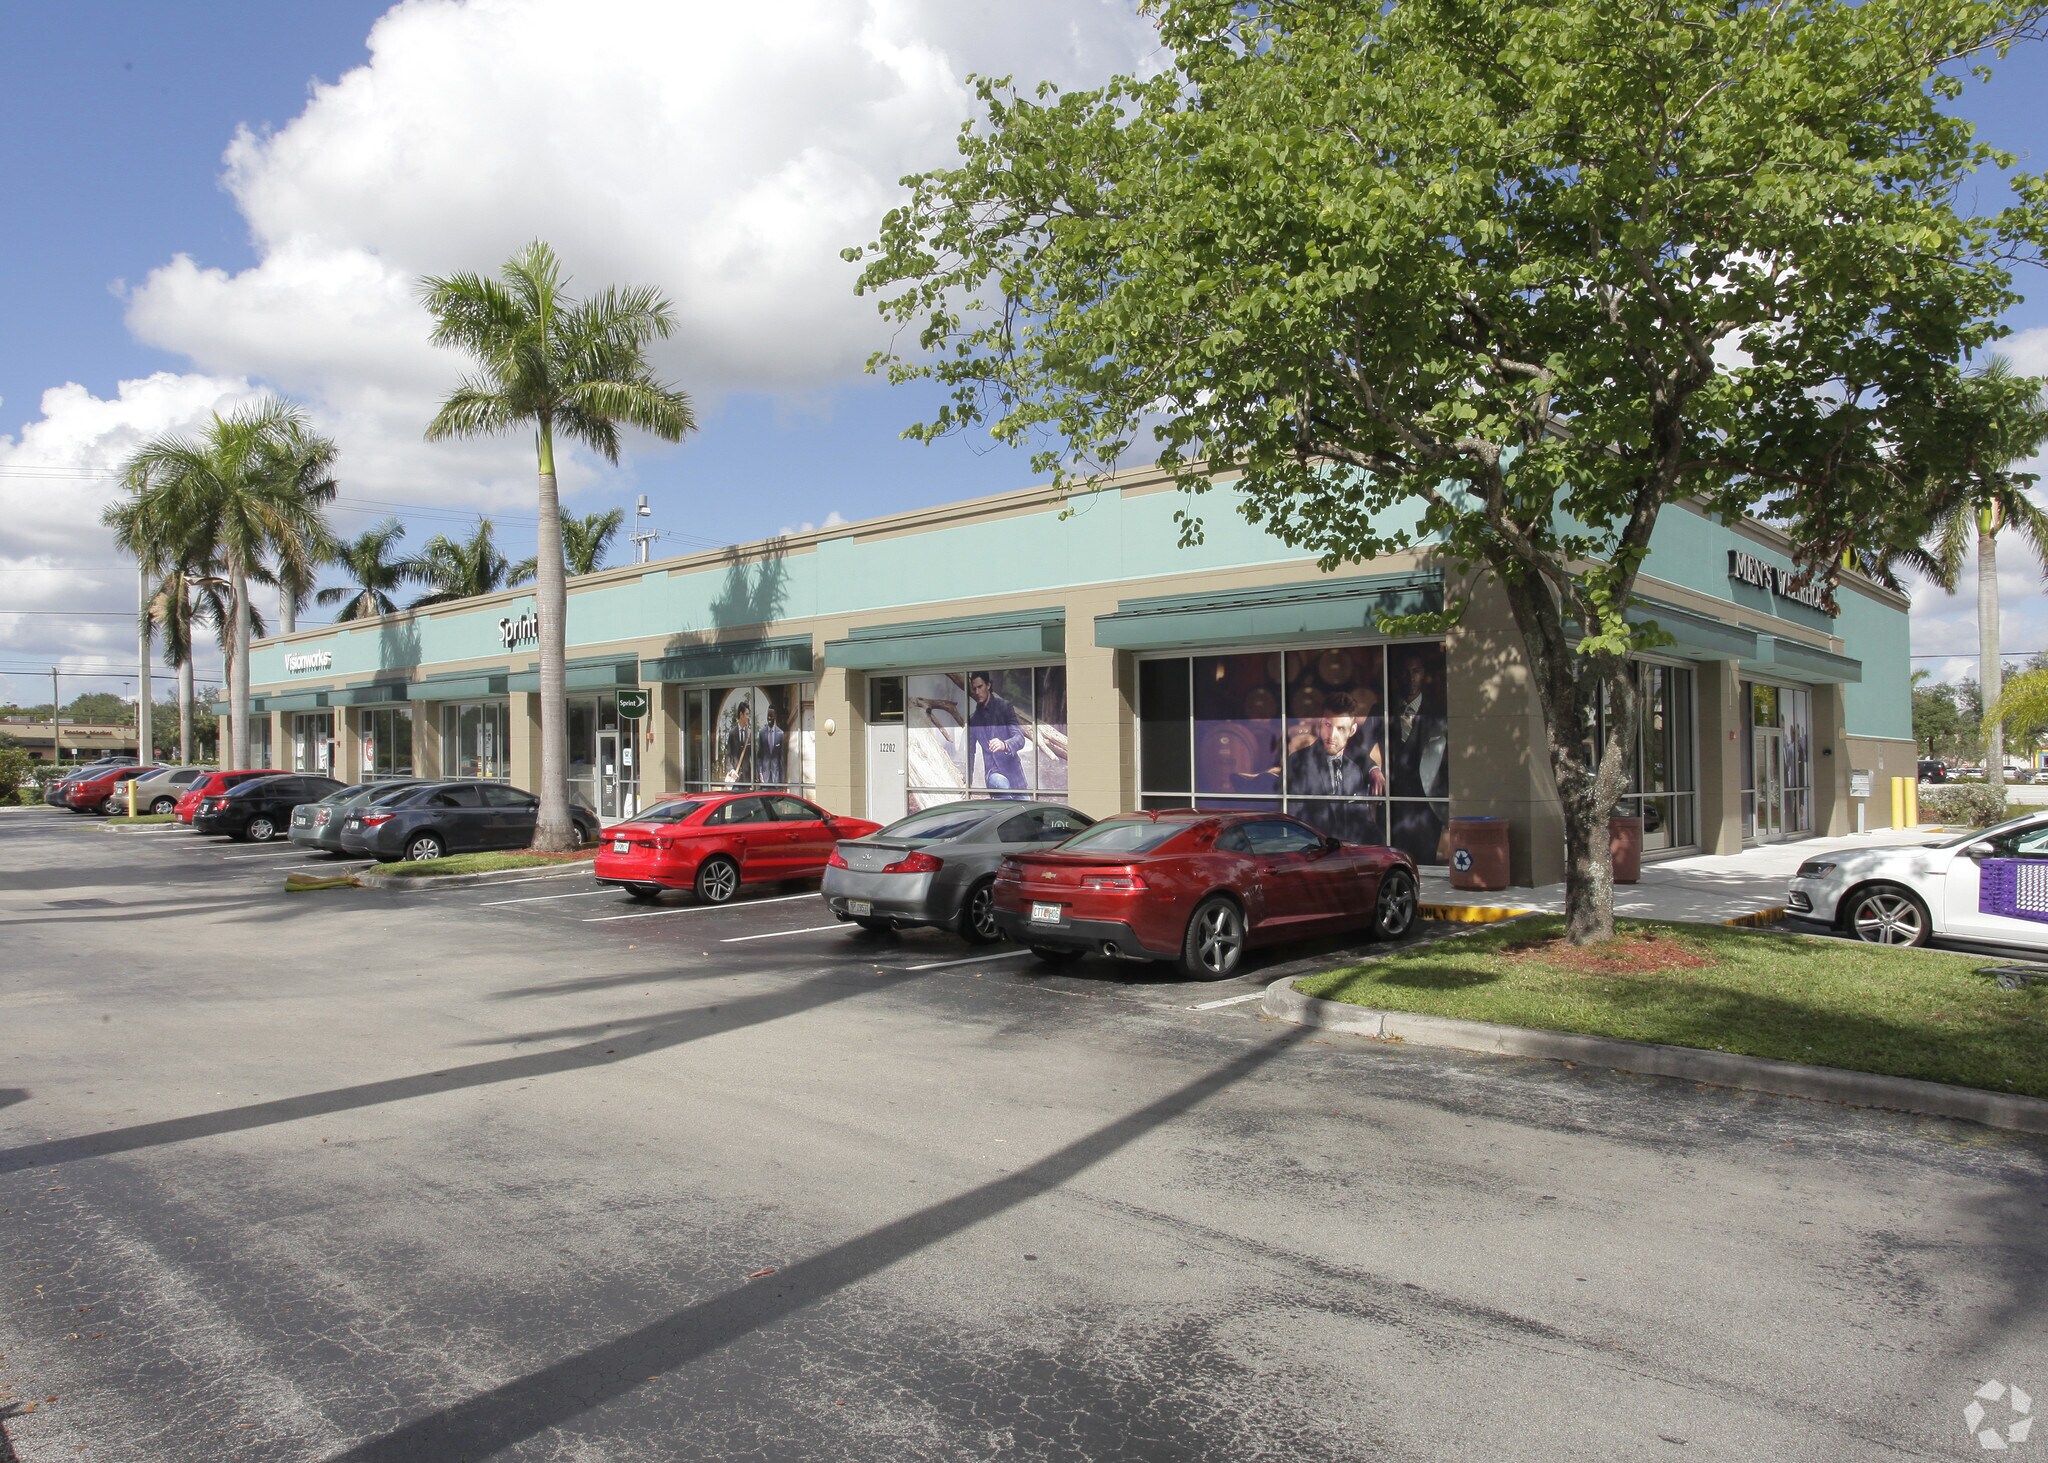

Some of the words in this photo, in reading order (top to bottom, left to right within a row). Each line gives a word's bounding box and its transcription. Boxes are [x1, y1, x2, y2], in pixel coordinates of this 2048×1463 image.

[1735, 550, 1773, 590] MEN'S
[499, 612, 537, 648] Sprint
[284, 649, 332, 671] Visionworks
[620, 699, 636, 707] Sprint
[879, 743, 896, 753] 12202
